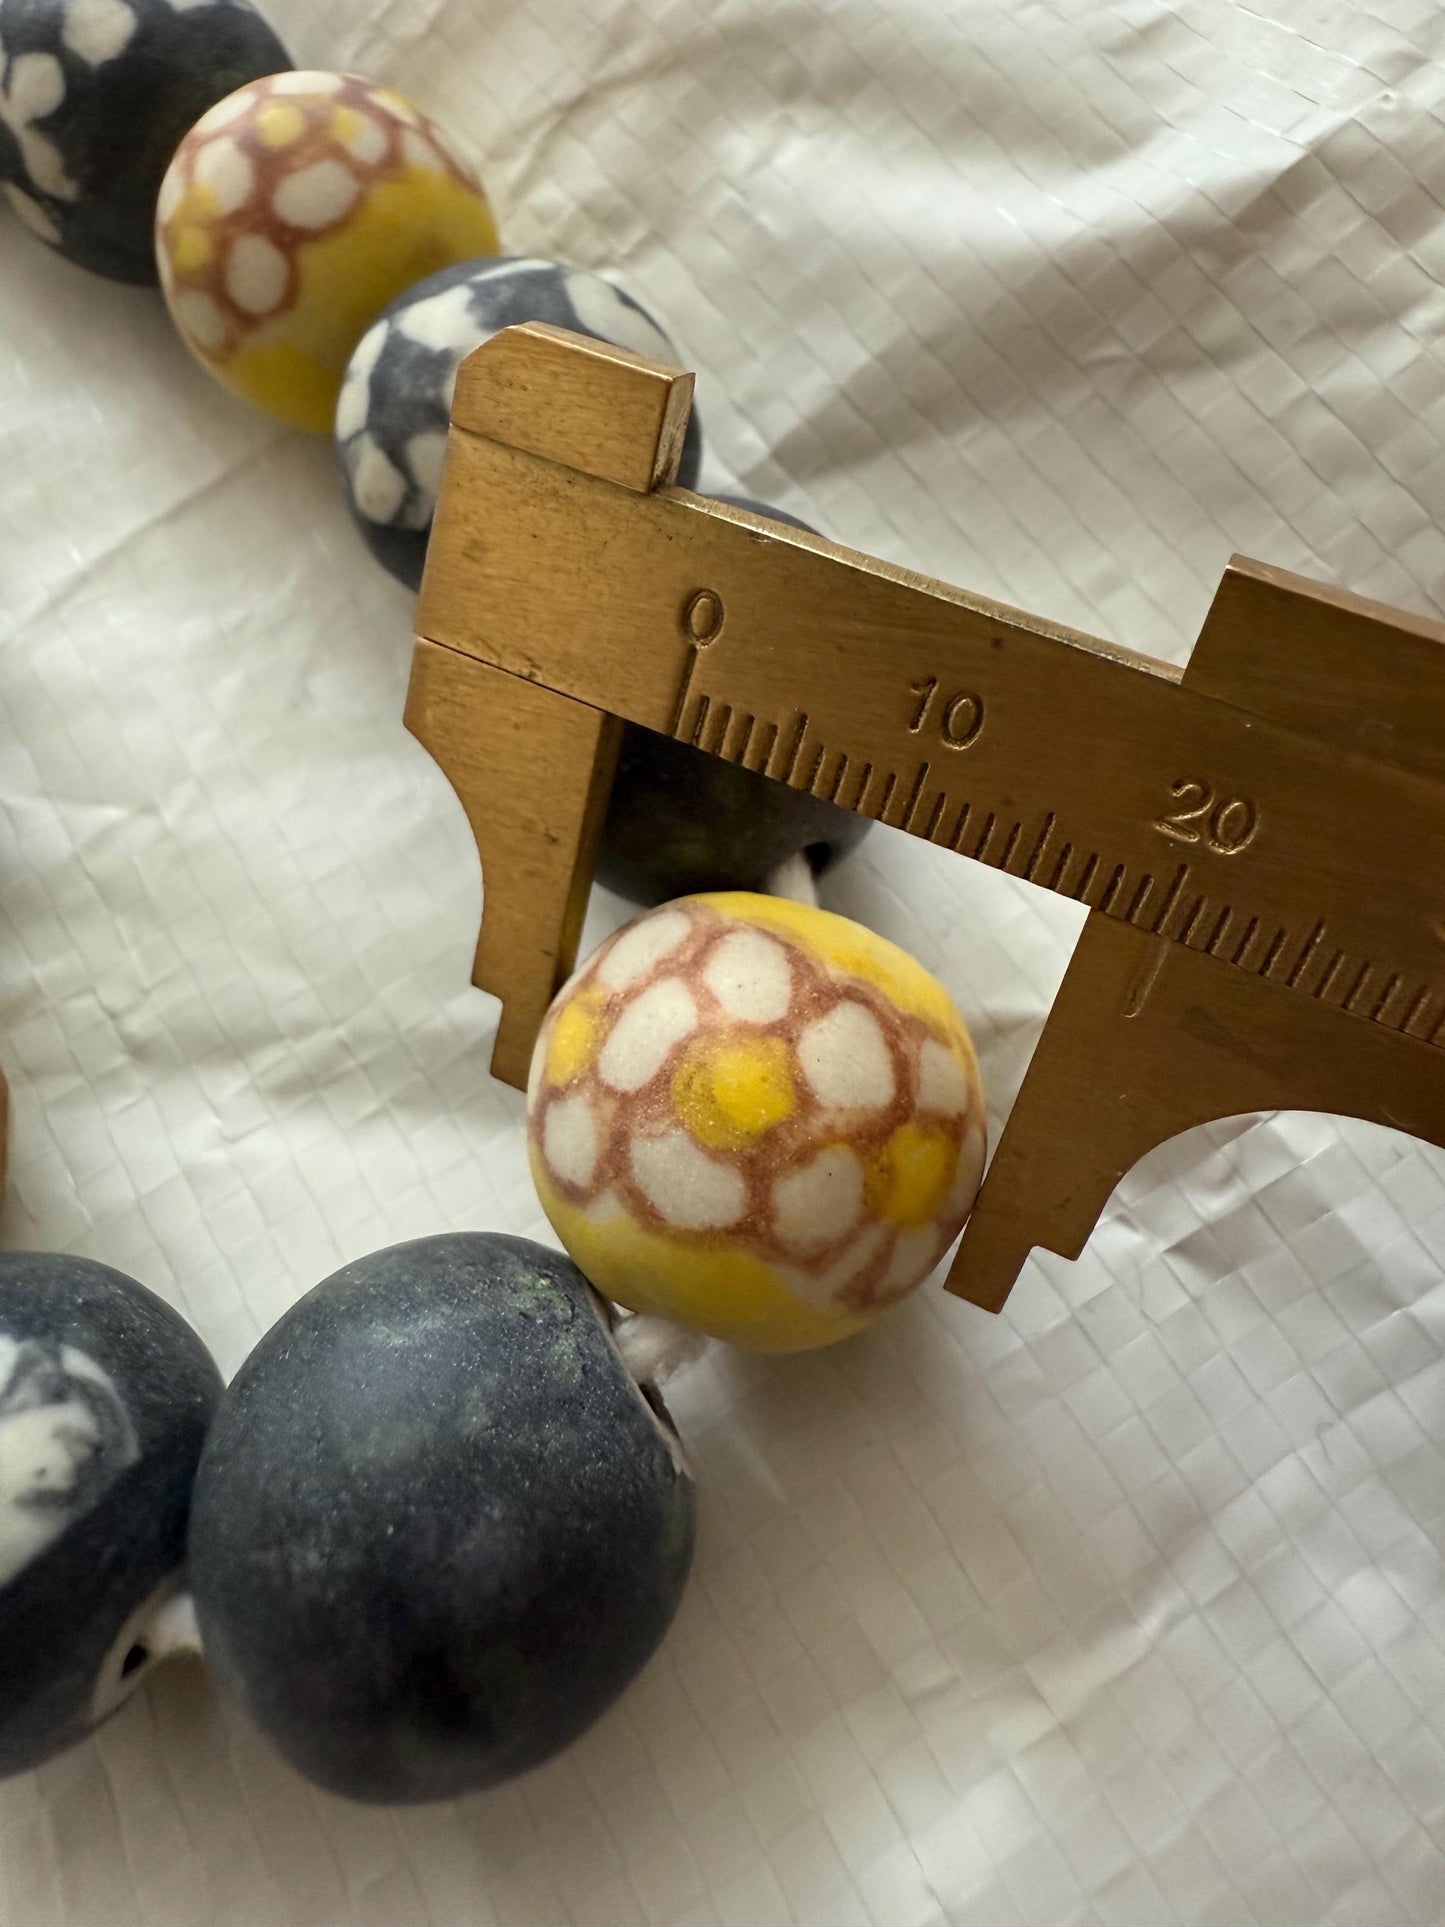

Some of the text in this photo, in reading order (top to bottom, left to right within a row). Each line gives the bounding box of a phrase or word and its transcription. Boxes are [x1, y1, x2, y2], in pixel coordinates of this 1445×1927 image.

[684, 588, 1259, 854] 0 10 20
